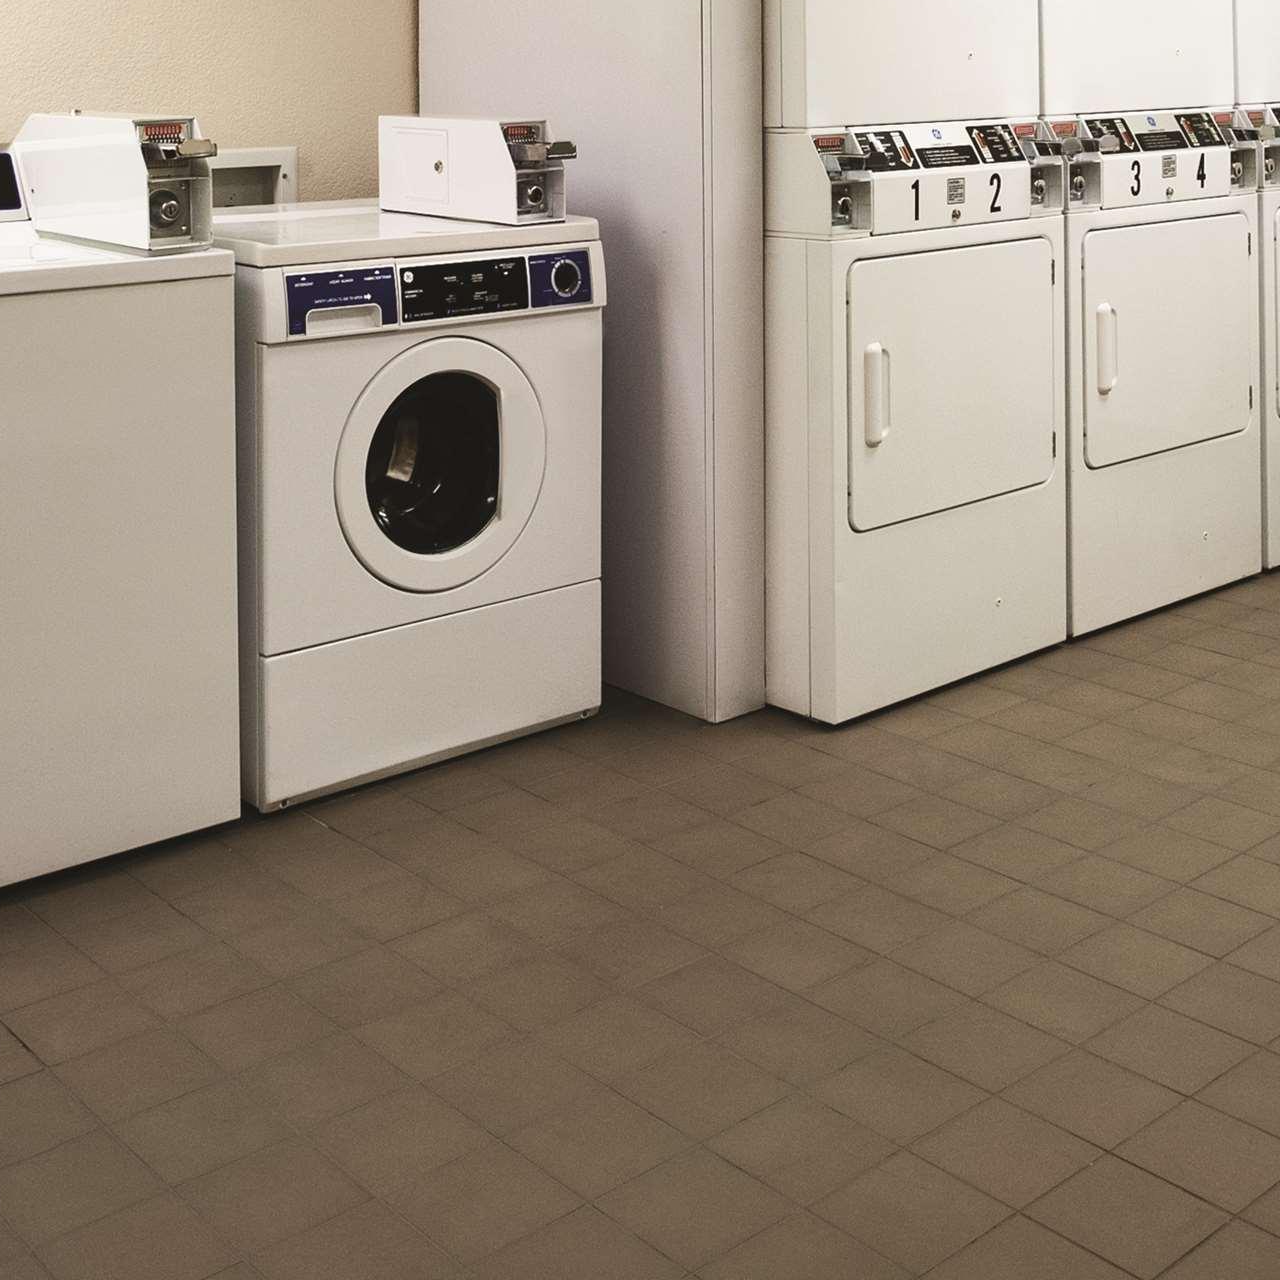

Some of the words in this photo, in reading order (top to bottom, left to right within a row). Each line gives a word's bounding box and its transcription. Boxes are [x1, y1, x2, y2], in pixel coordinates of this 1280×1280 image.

[1130, 160, 1141, 197] 3
[1196, 152, 1207, 189] 4
[910, 179, 920, 221] 1
[989, 173, 1002, 213] 2
